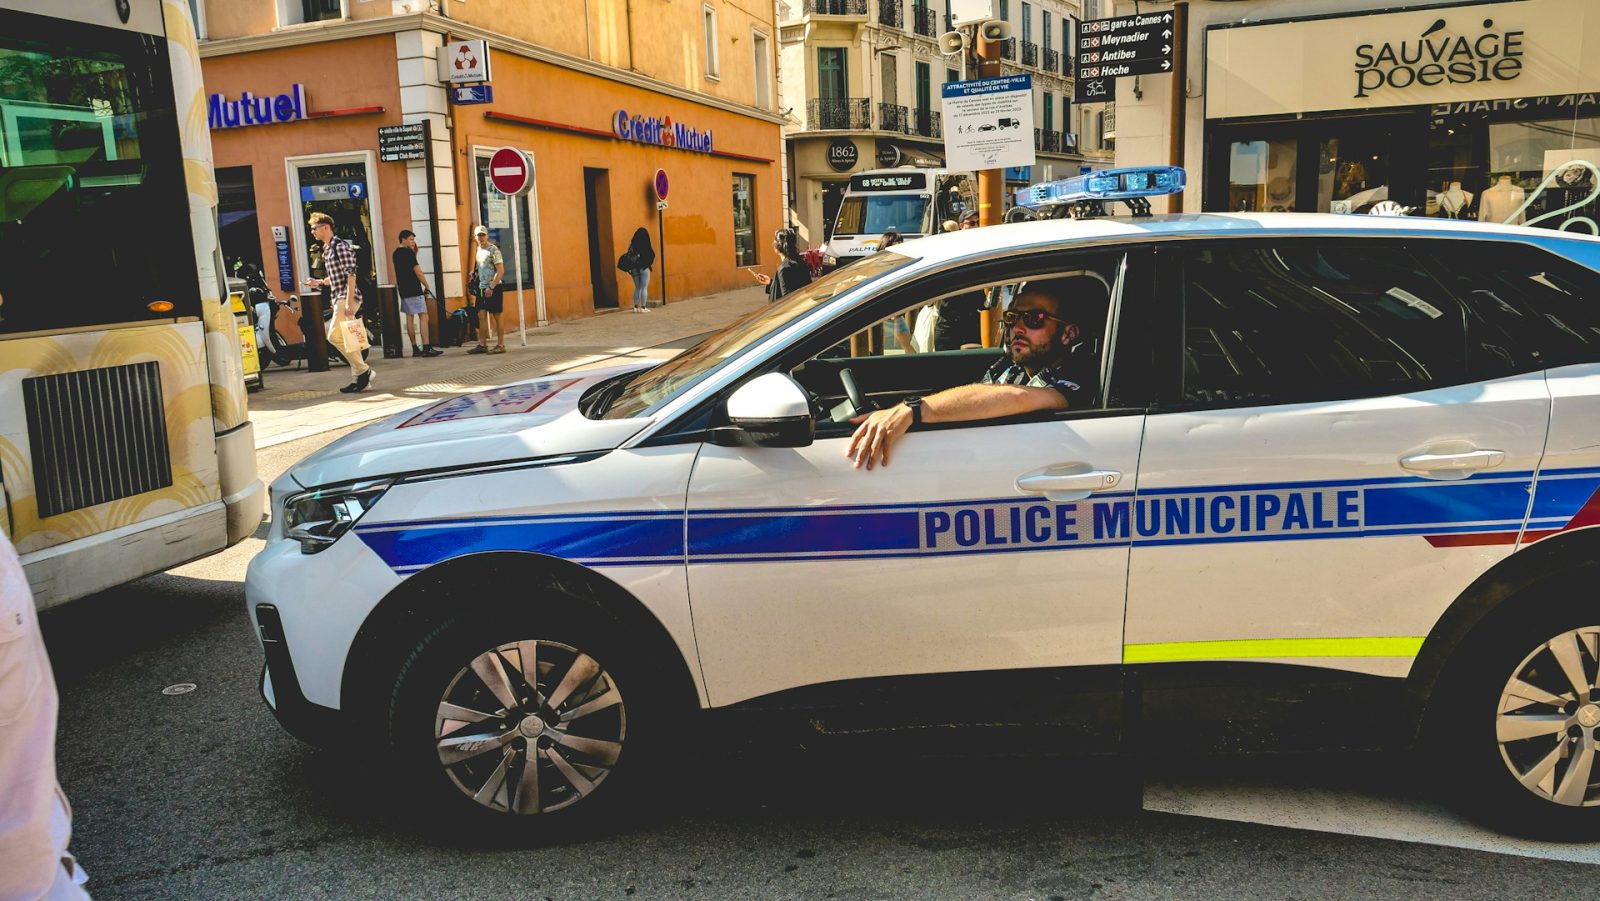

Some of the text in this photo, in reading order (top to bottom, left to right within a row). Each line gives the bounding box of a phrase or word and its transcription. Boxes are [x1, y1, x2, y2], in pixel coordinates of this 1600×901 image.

[1111, 20, 1126, 31] gare
[1135, 15, 1161, 26] Cannes
[1101, 31, 1149, 46] Meynadier
[1101, 49, 1136, 61] Antibes
[1101, 65, 1130, 76] Hoche
[947, 80, 981, 90] ATTRACTIVITÉ
[990, 76, 1026, 85] CENTRE-VILLE
[971, 84, 992, 93] QUALITÉ
[614, 110, 713, 152] Crédit Mutuel
[832, 146, 855, 157] 1862
[925, 490, 1359, 548] POLICE MUNICIPALE
